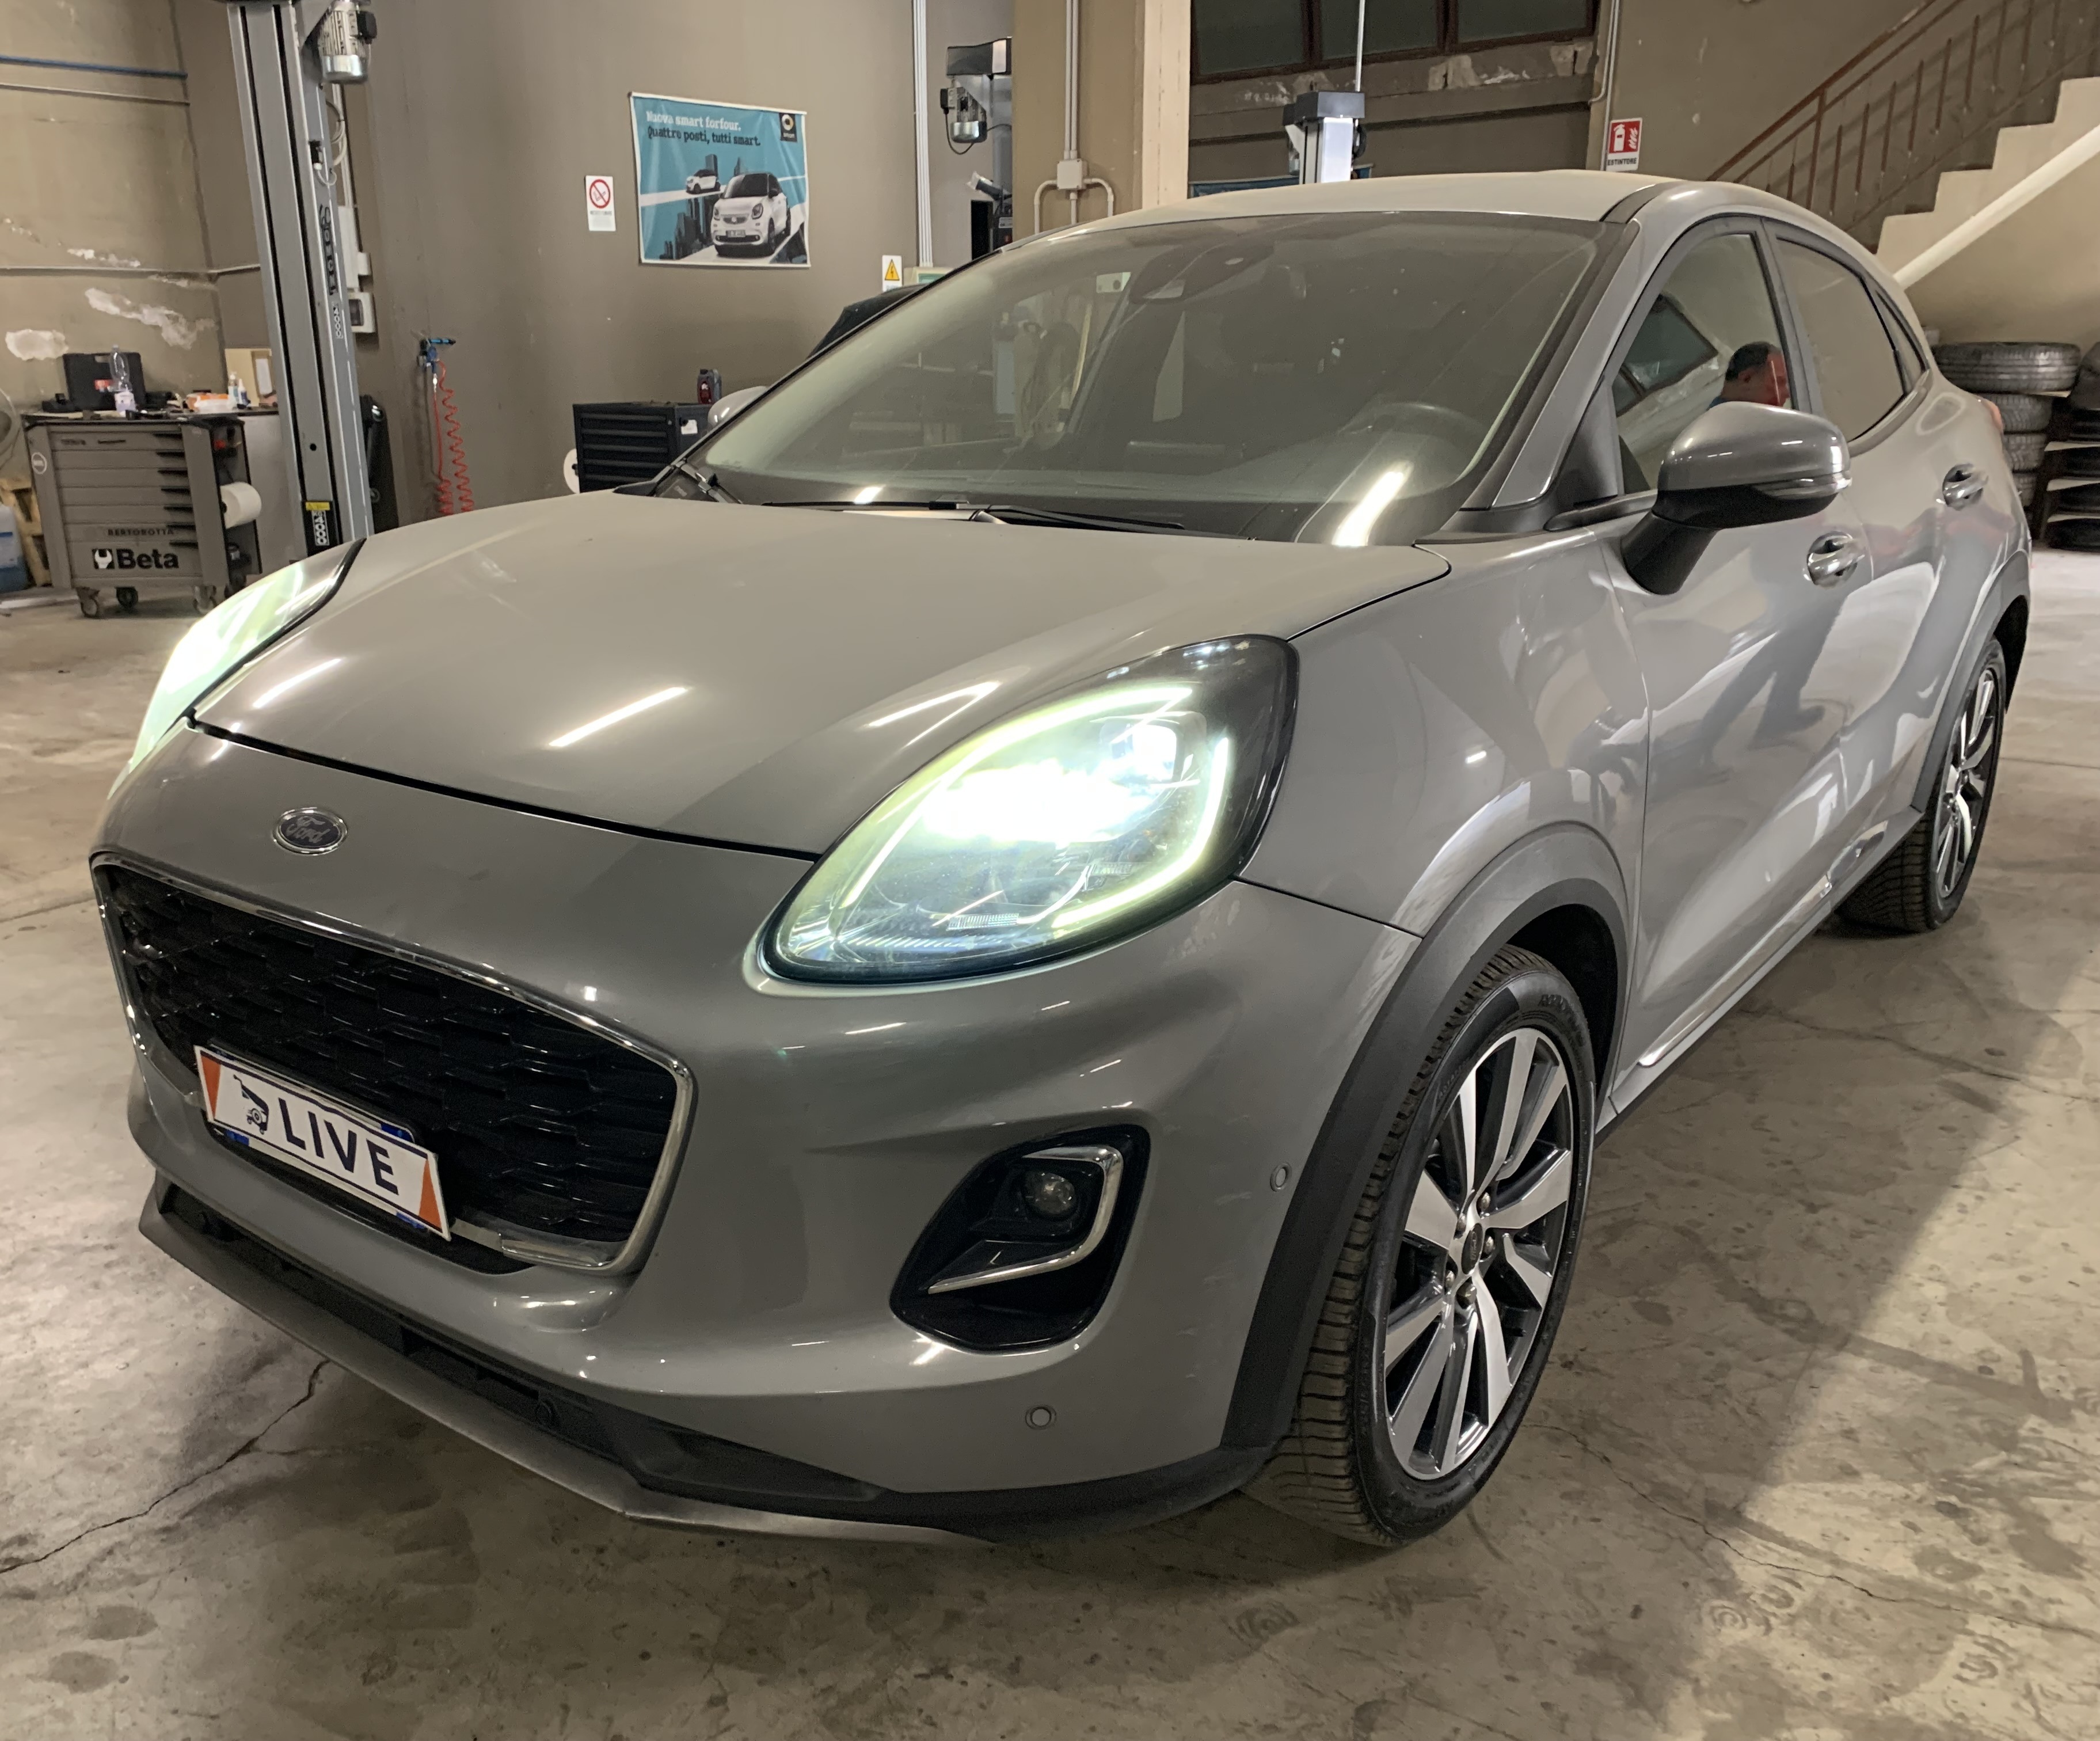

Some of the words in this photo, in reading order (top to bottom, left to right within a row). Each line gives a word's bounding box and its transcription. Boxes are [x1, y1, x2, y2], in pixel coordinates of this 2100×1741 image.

[646, 111, 674, 124] Nuova
[675, 115, 703, 127] smart
[706, 116, 741, 131] forfour.
[648, 126, 682, 139] Quattro
[683, 130, 710, 145] posti,
[712, 132, 732, 143] tutti
[733, 136, 761, 146] smart.
[1607, 157, 1637, 166] ESTINTORE
[116, 548, 180, 569] Beta
[286, 815, 331, 843] Ford
[277, 1097, 400, 1196] LIVE
